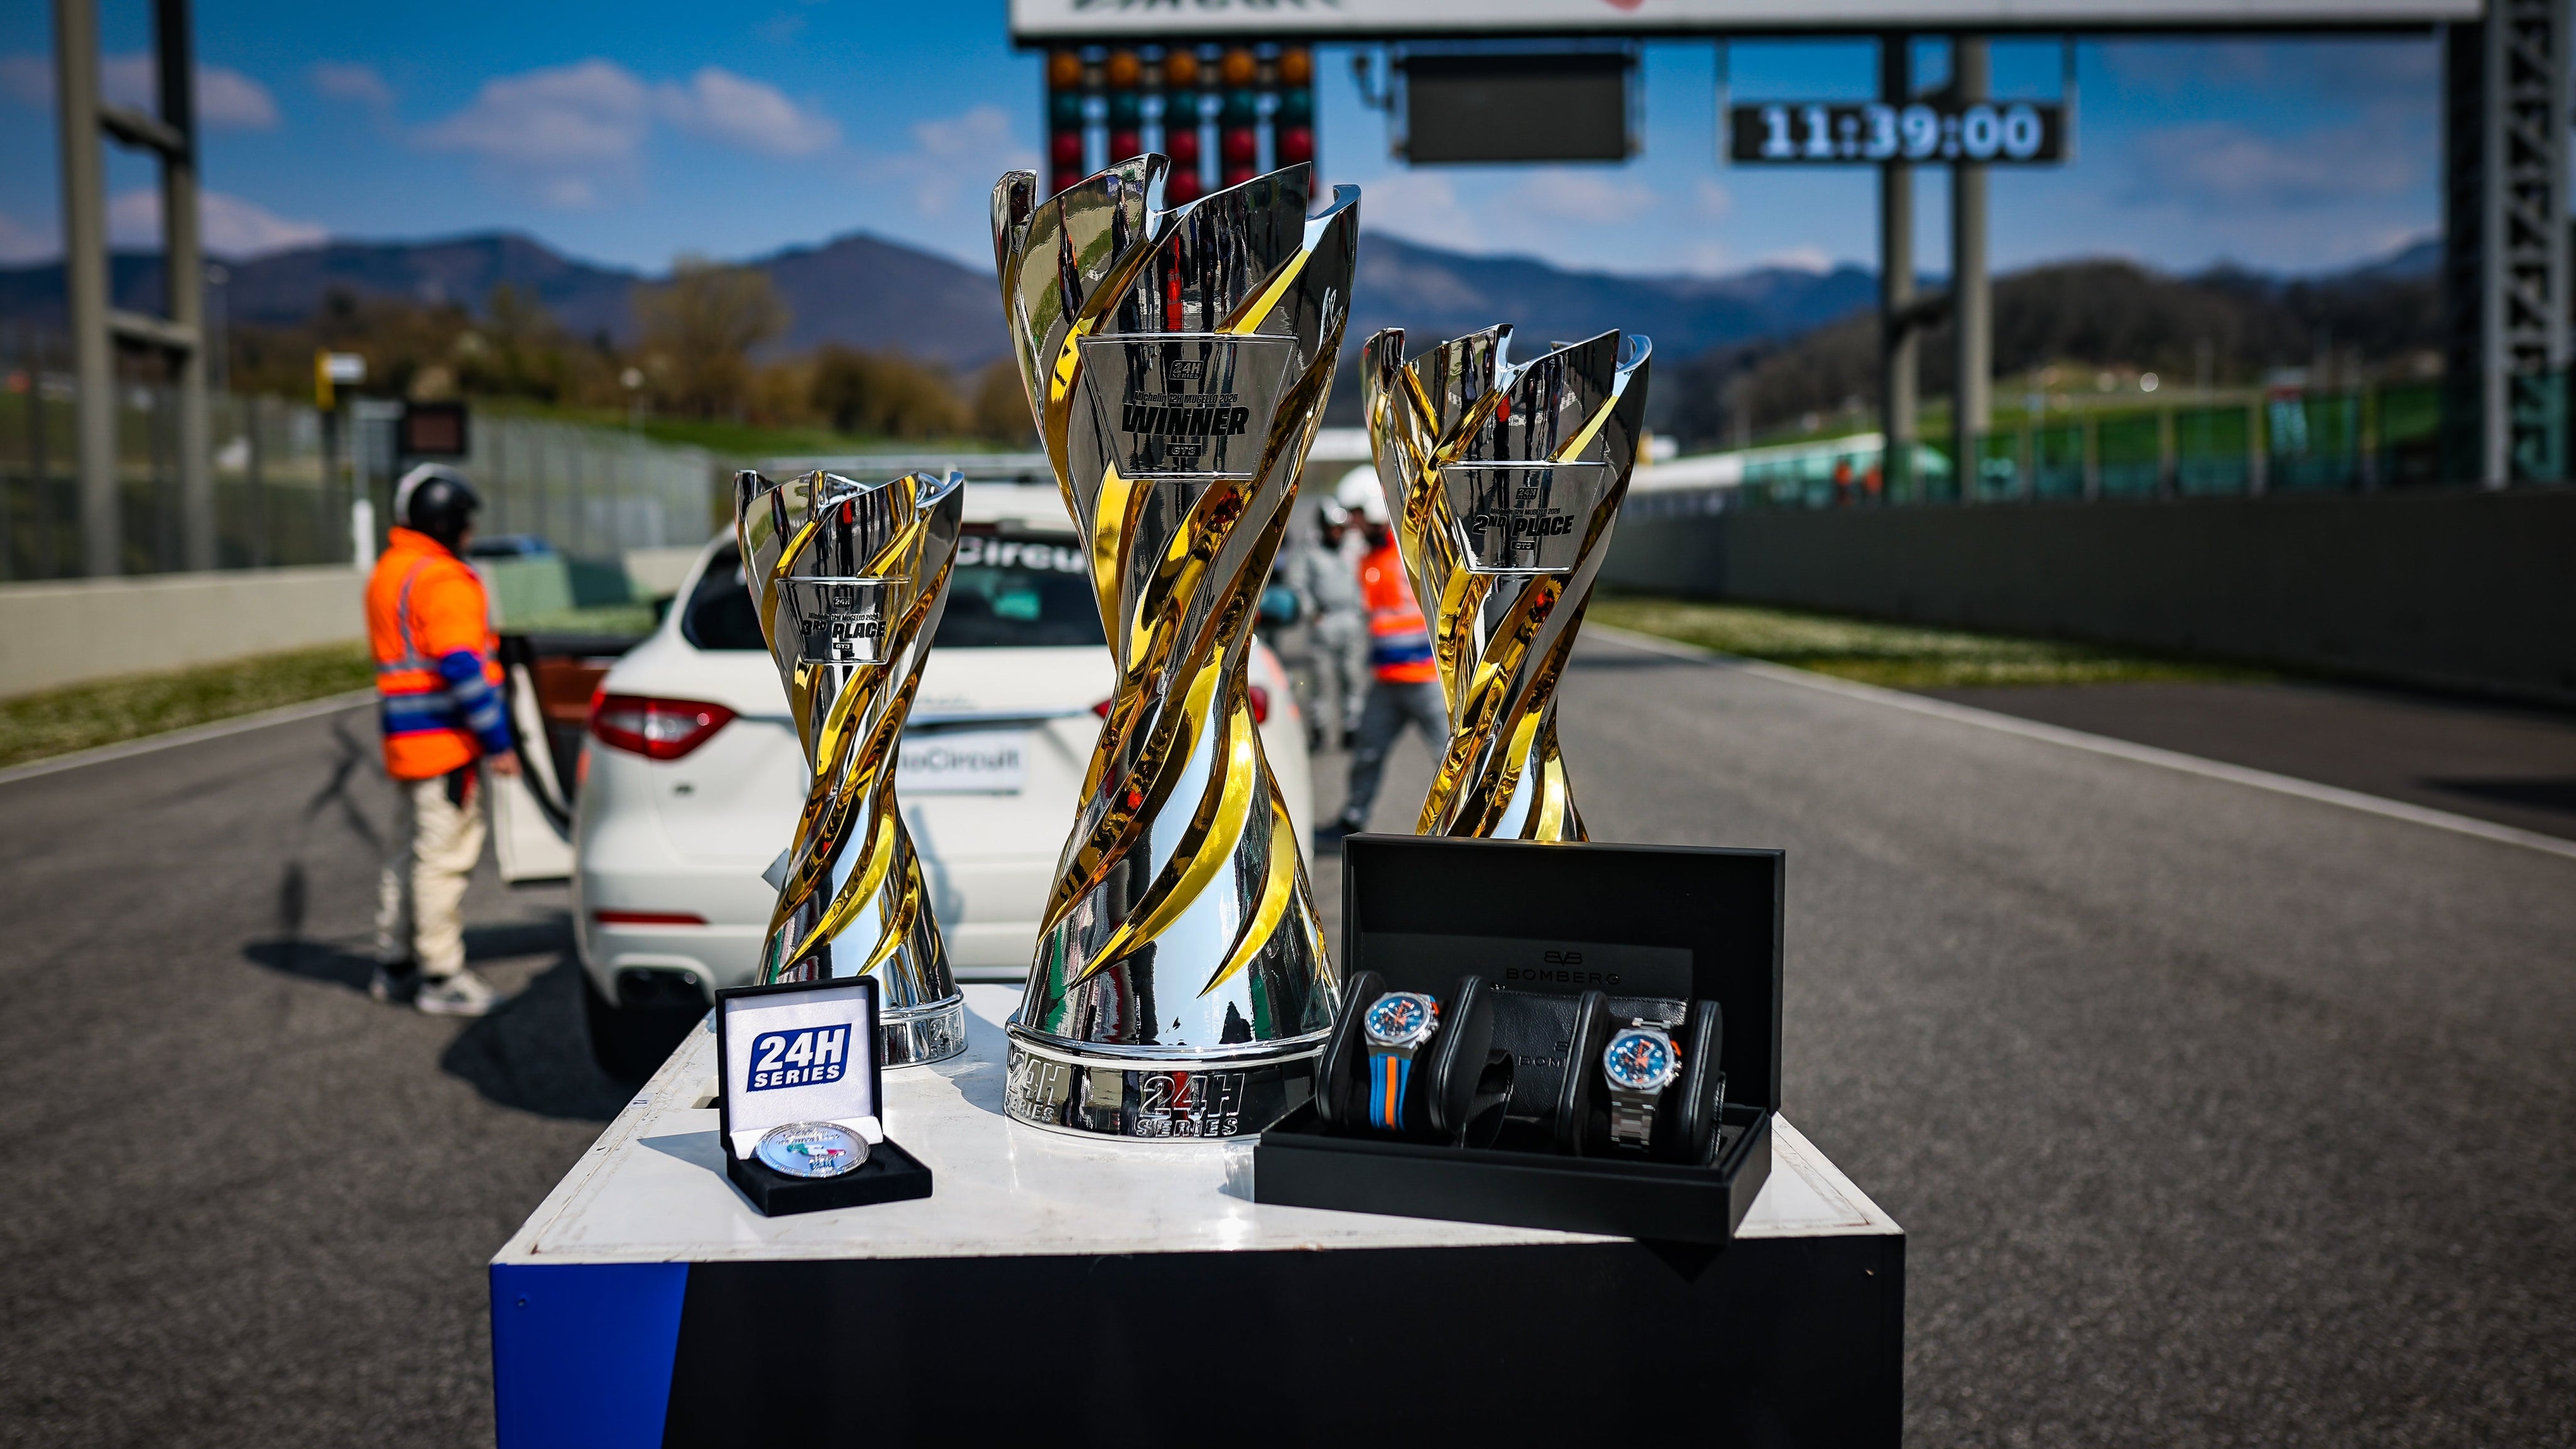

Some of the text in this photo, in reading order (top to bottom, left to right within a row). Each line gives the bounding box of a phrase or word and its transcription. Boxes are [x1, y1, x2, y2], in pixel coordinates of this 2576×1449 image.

[1762, 104, 2043, 160] 11:39:00
[1173, 363, 1201, 373] 24H
[1134, 391, 1238, 403] Michelin 12H MUGELLO 2026
[1122, 403, 1250, 436] WINNER
[1172, 446, 1196, 455] GT3
[1472, 515, 1575, 537] 2ND PLACE
[801, 620, 887, 638] 3RD PLACE
[1506, 968, 1620, 985] BOMBERG
[756, 1029, 845, 1072] 24H
[754, 1065, 840, 1088] SERIES
[1008, 1053, 1066, 1106] 24H
[1140, 1073, 1245, 1118] 24H
[1135, 1118, 1238, 1137] SERIES
